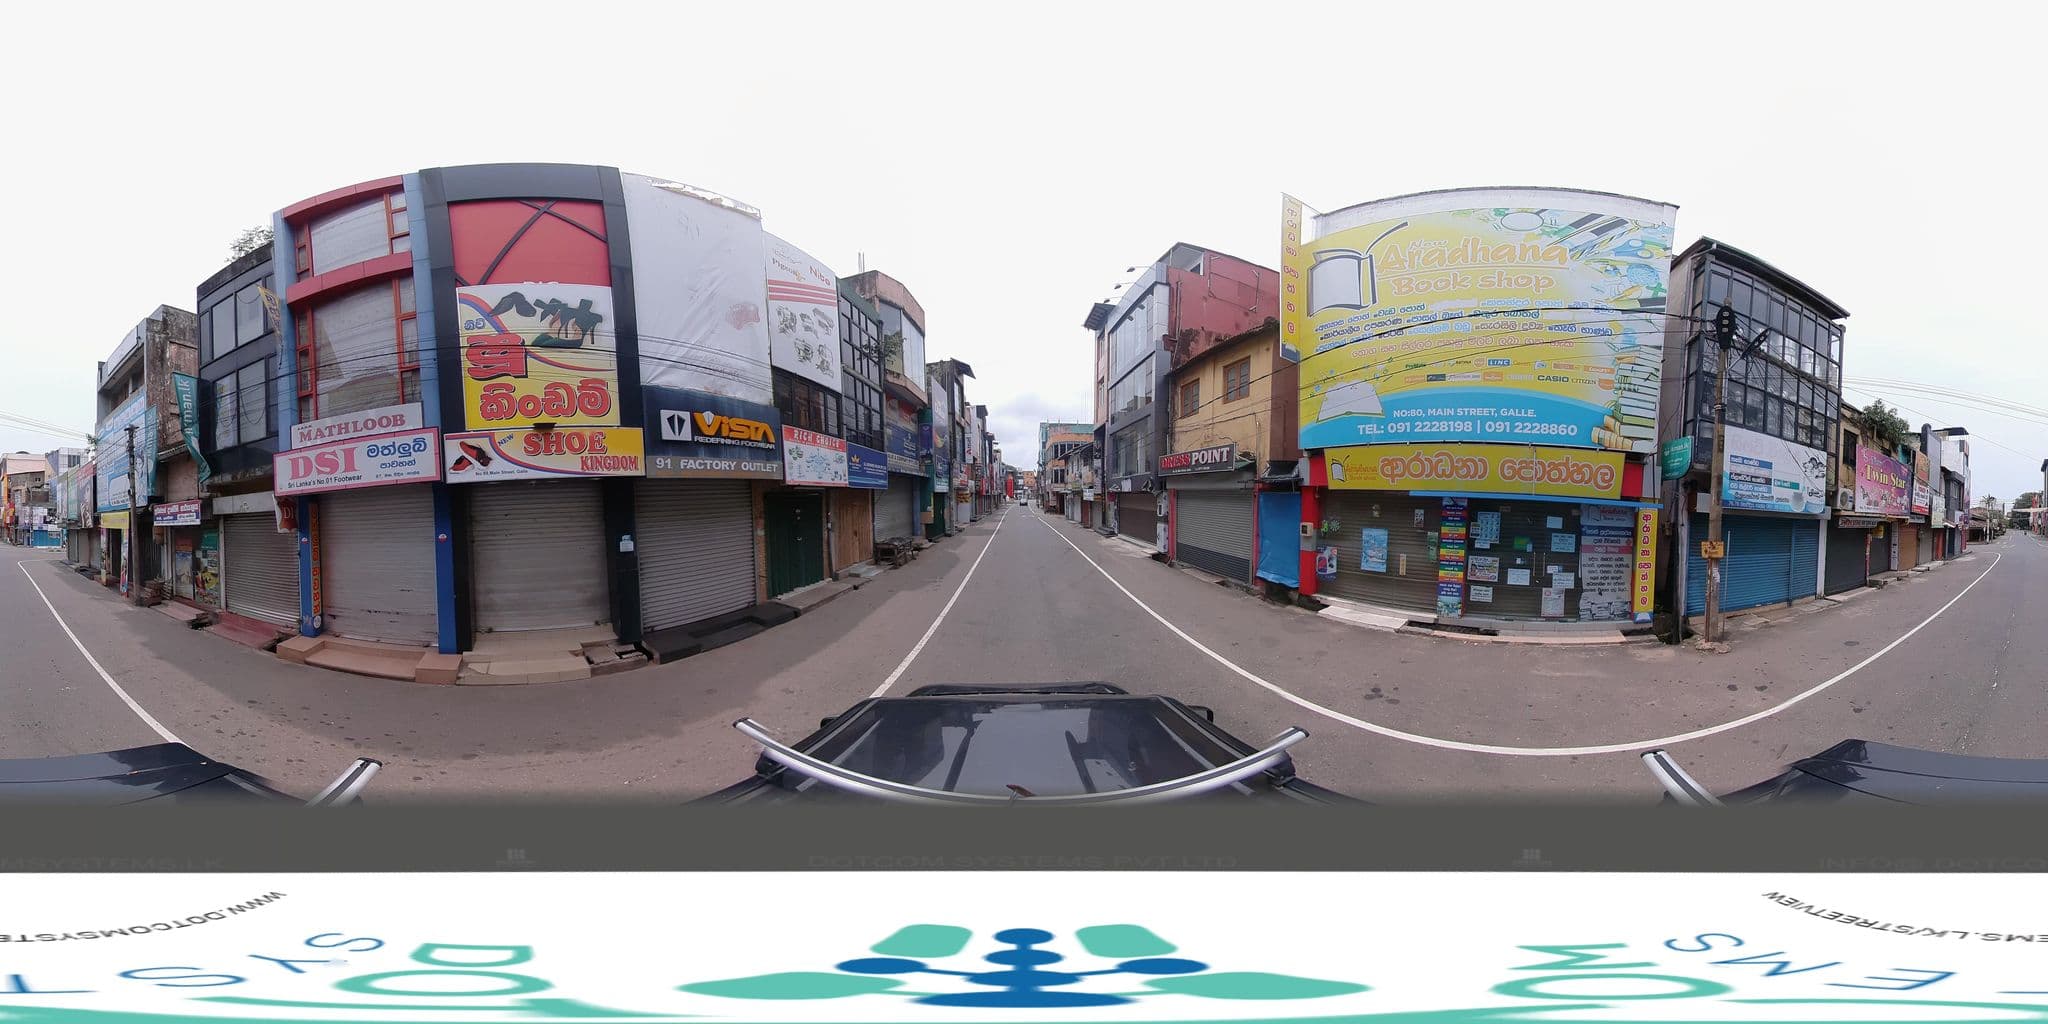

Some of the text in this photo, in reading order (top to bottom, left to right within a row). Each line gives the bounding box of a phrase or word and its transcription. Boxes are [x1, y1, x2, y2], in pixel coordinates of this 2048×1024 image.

[1378, 238, 1569, 273] Aradhana
[1392, 270, 1555, 296] Book shop
[1537, 374, 1569, 383] CASIO
[480, 377, 612, 422] කිංඩම්
[1427, 408, 1454, 417] MAIN
[1457, 408, 1498, 417] STREET,
[1500, 408, 1537, 418] GALLE.
[299, 413, 406, 443] MATHLOOB
[498, 433, 514, 446] NEW
[1358, 423, 1385, 436] TEL:
[1387, 421, 1411, 434] 091
[1414, 420, 1473, 433] 2228198
[1485, 421, 1512, 434] 091
[1514, 421, 1578, 436] 2228860
[523, 431, 607, 456] SHOE
[694, 435, 740, 446] REDEFINING
[288, 446, 361, 481] DSI
[580, 455, 639, 472] KINGDOM
[655, 457, 778, 473] 91 FACTORY OUTLET
[1161, 447, 1230, 470] DRESS POINT
[287, 481, 296, 489] Sri
[334, 474, 363, 484] Footwear
[1379, 451, 1615, 491] ආරාධනා පොත්හල
[1865, 464, 1906, 489] Twin Star
